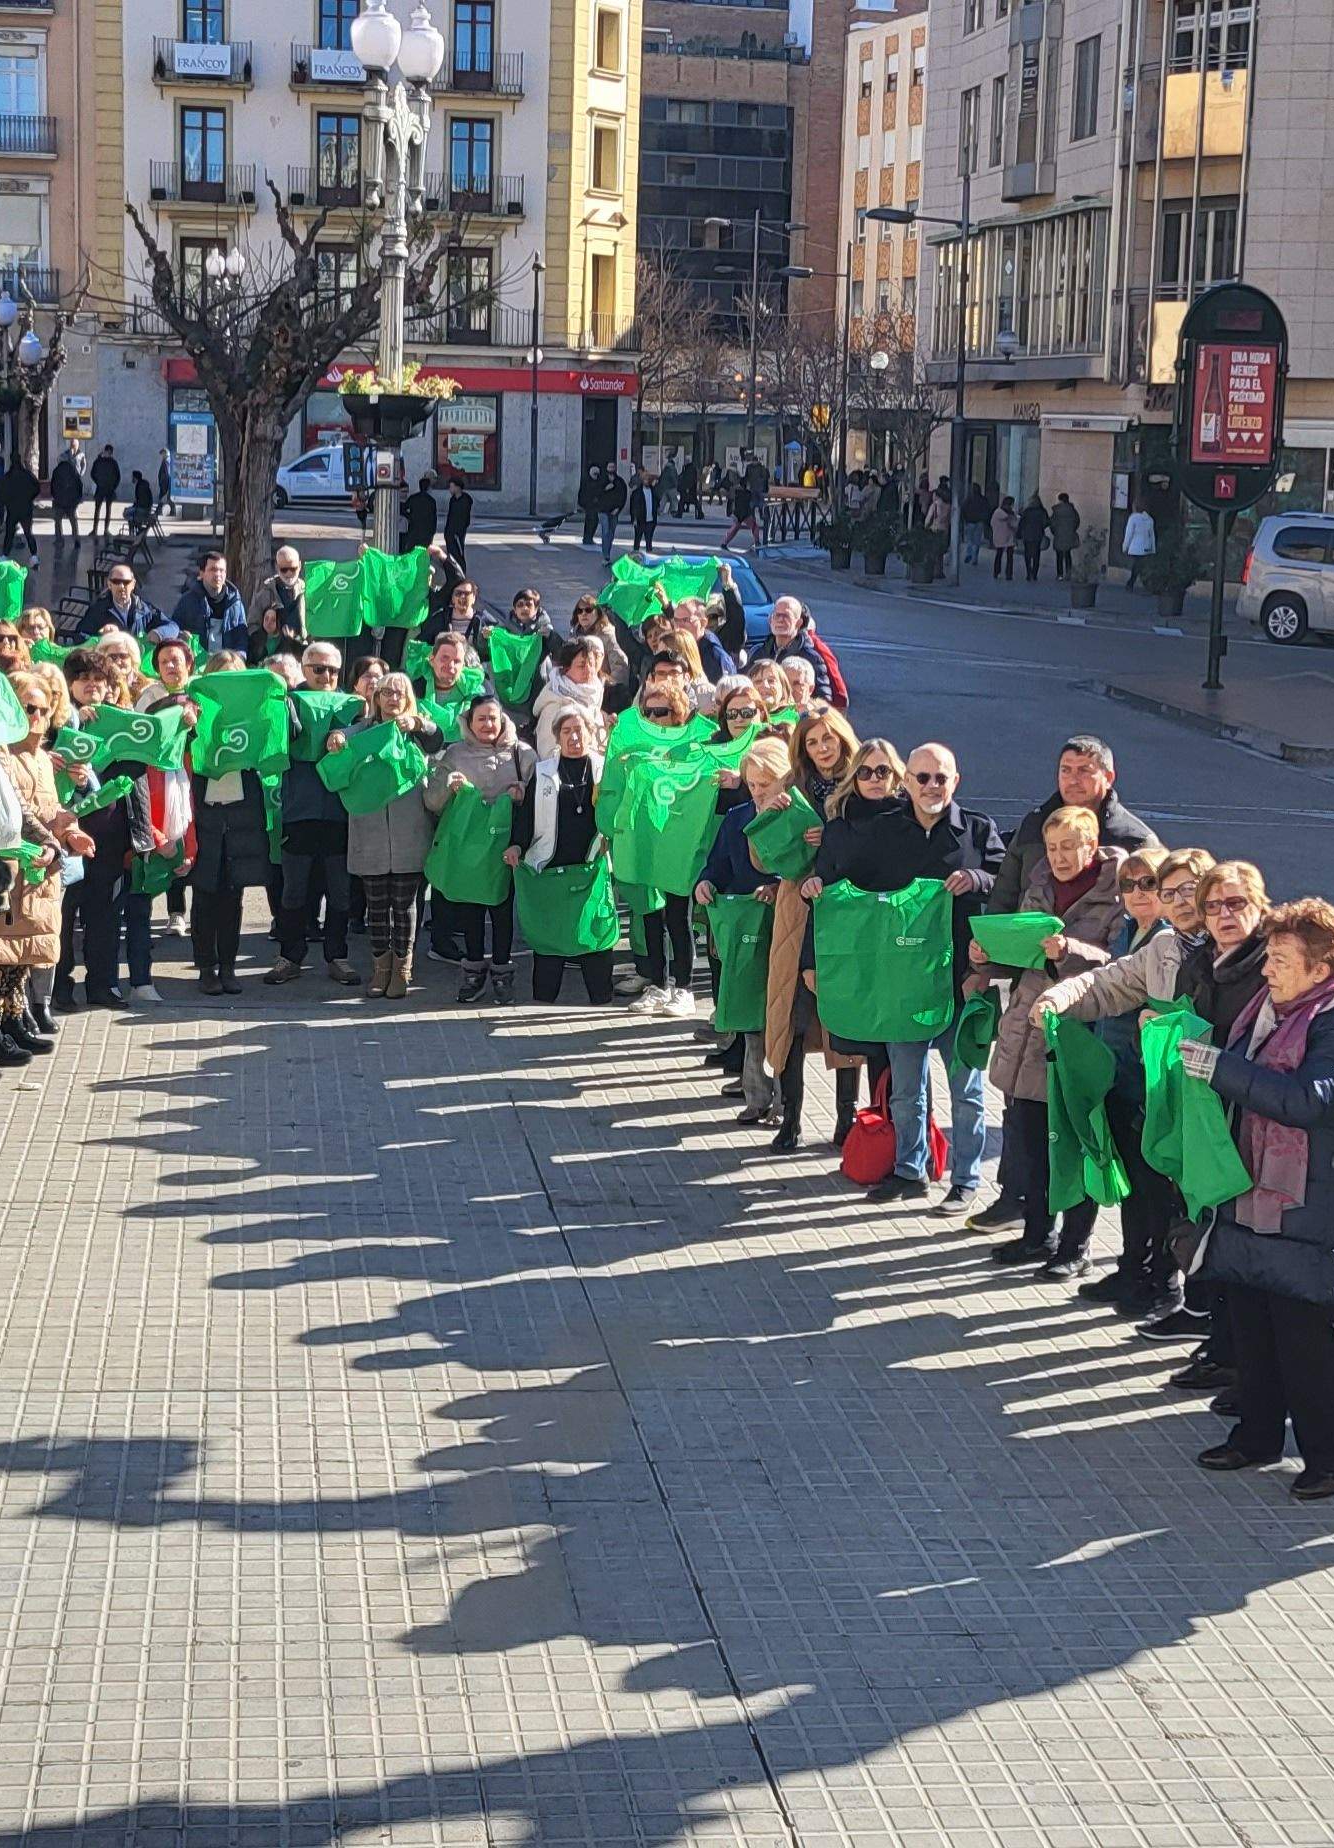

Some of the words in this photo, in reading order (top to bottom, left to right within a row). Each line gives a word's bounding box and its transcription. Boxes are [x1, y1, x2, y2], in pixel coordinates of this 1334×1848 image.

[177, 57, 228, 70] FRANCOY
[1231, 351, 1247, 363] UNA
[1249, 352, 1271, 364] HORA
[1230, 364, 1259, 377] MENOS
[589, 377, 626, 391] Santander
[1229, 378, 1250, 389] PARA
[1252, 378, 1262, 390] EL
[1013, 402, 1041, 420] MANGO
[1228, 404, 1245, 416] SAN
